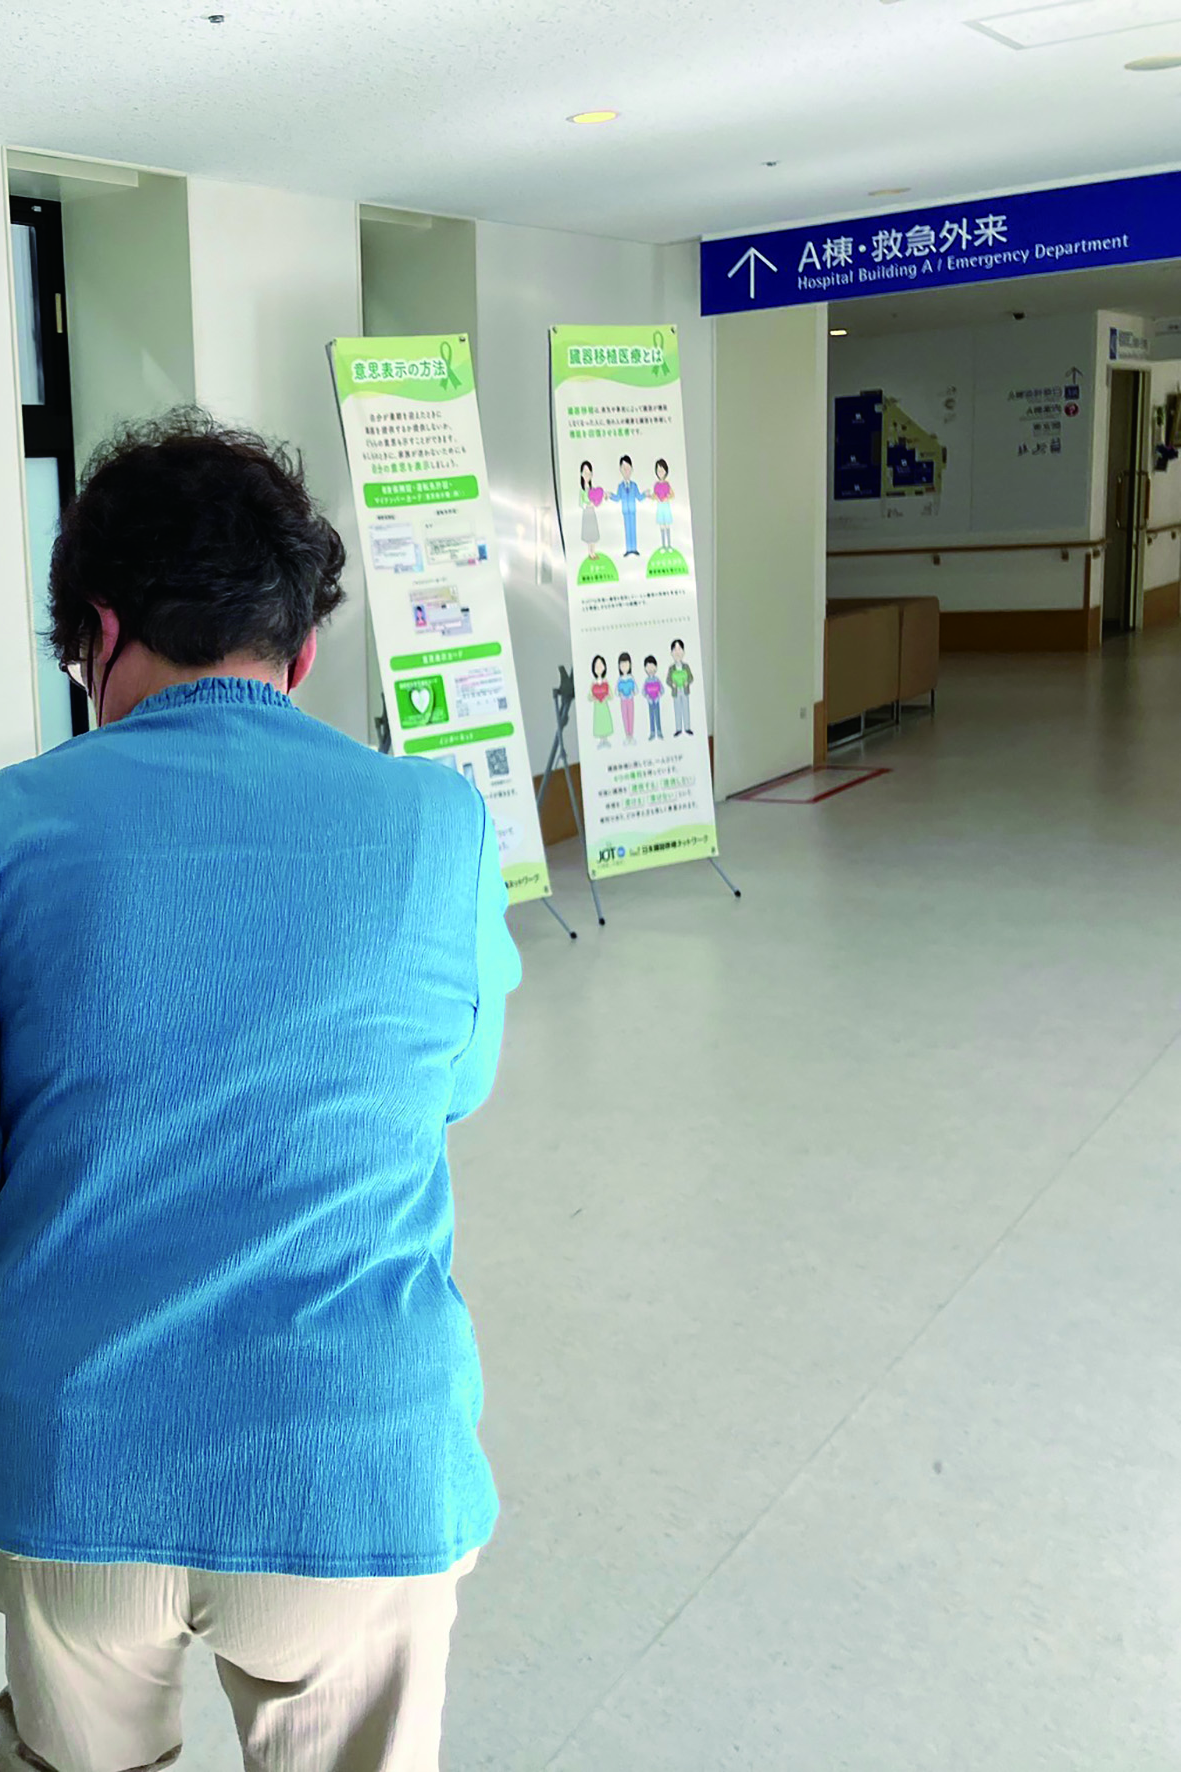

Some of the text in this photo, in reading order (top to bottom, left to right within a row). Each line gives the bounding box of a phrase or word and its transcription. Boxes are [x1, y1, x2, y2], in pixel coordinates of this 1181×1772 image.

[797, 270, 854, 291] Hospital
[859, 262, 918, 284] Building
[921, 258, 934, 273] A
[947, 247, 1030, 271] Emergency
[1035, 233, 1130, 259] Department
[798, 214, 1008, 273] A棟・救急外来
[353, 360, 446, 381] 意思表示の方法
